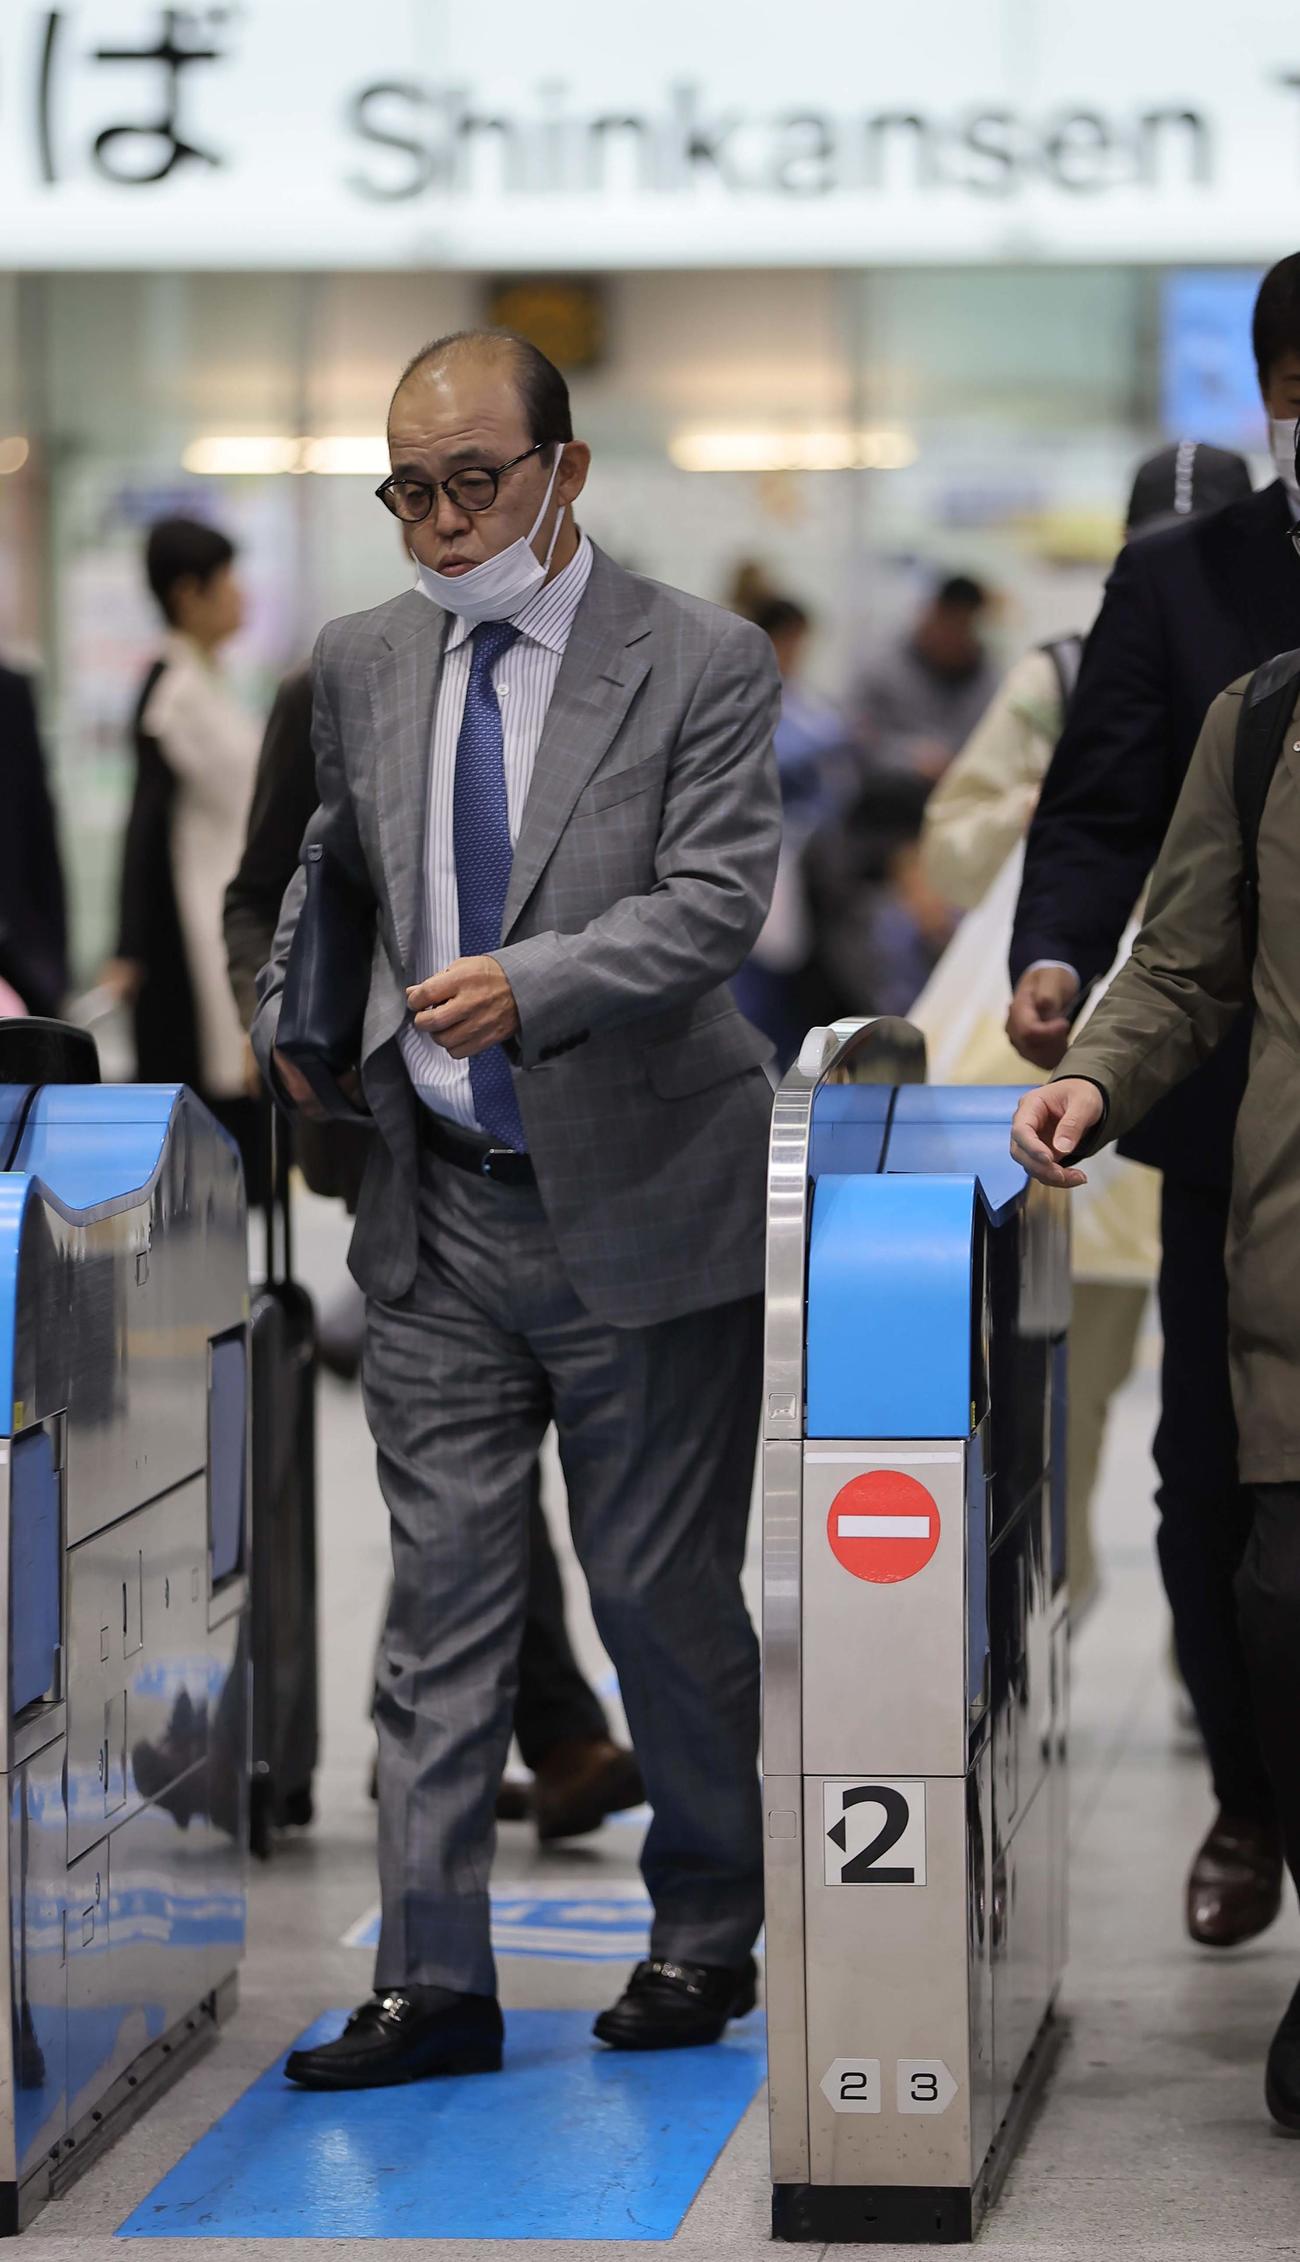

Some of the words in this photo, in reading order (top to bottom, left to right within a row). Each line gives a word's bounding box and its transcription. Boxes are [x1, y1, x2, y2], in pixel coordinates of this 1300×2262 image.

[346, 78, 1215, 201] Shinkansen
[840, 1785, 915, 1884] 2
[839, 2071, 868, 2101] 2
[910, 2072, 939, 2102] 3
